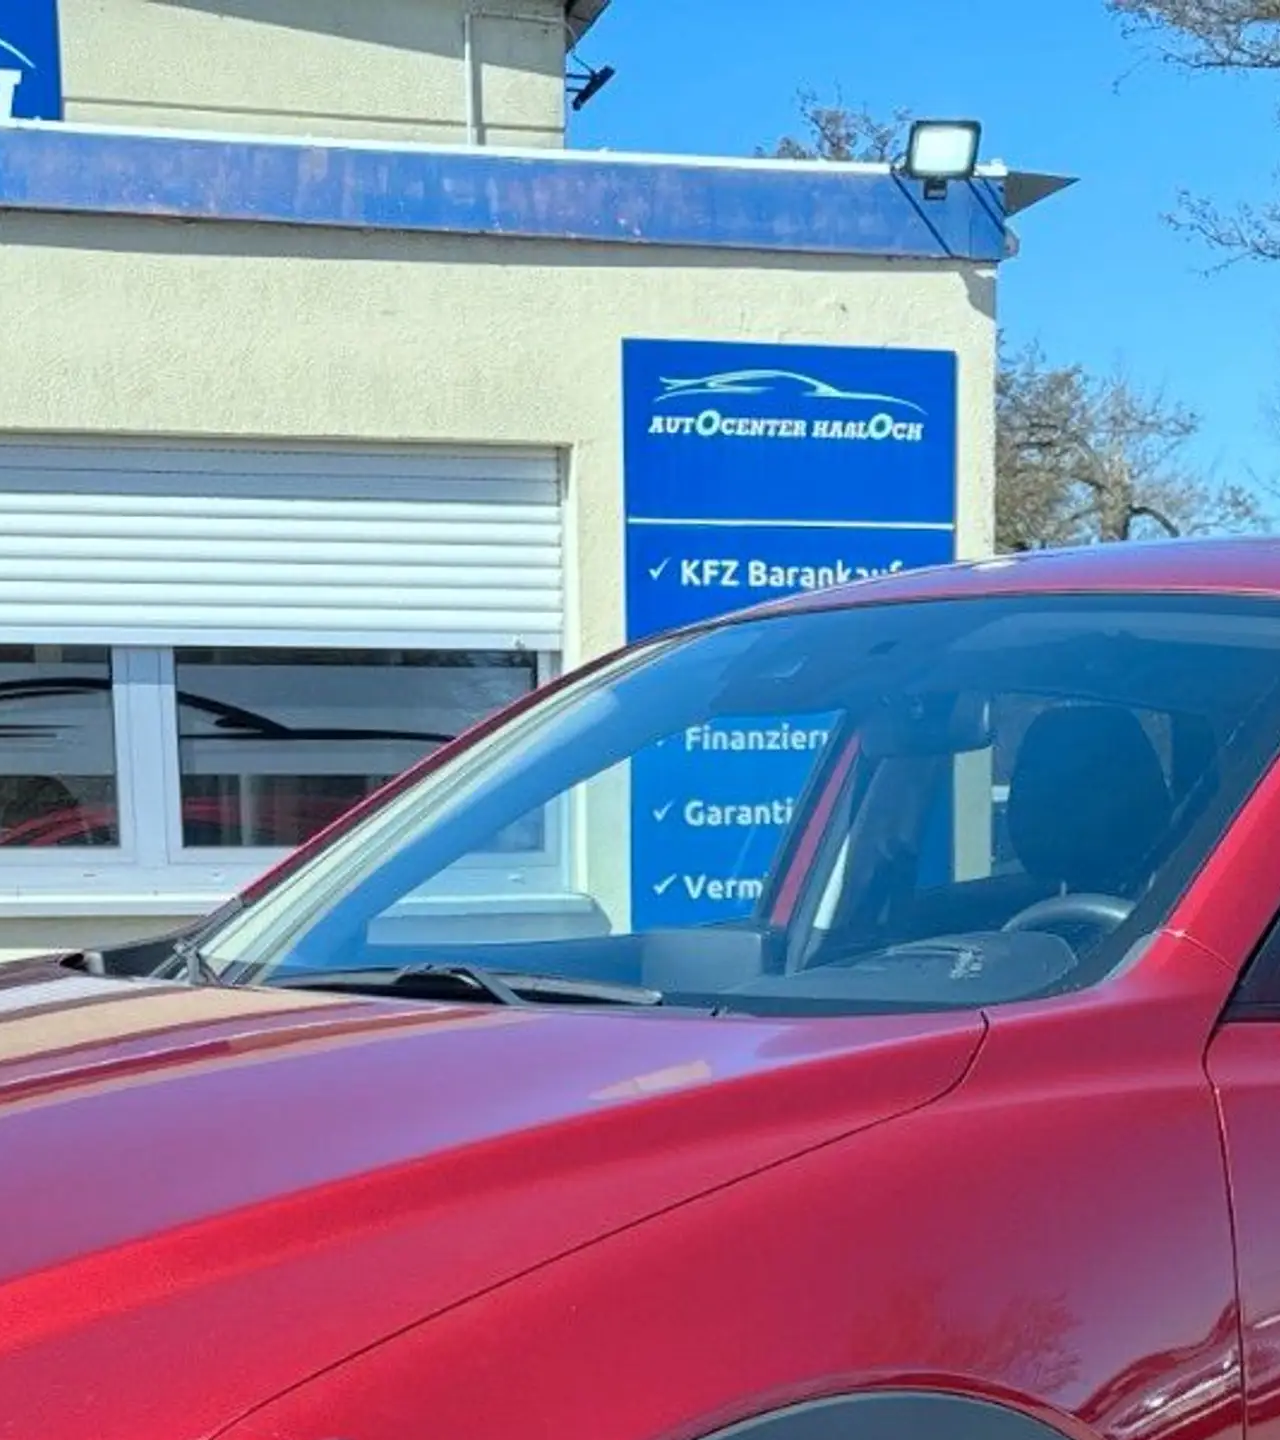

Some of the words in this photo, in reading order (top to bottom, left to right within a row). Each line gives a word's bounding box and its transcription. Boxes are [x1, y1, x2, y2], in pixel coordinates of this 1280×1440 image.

[648, 410, 807, 438] AUTOCENTER
[680, 559, 740, 587] KFZ
[747, 559, 904, 589] Barank
[683, 871, 769, 899] Verm
